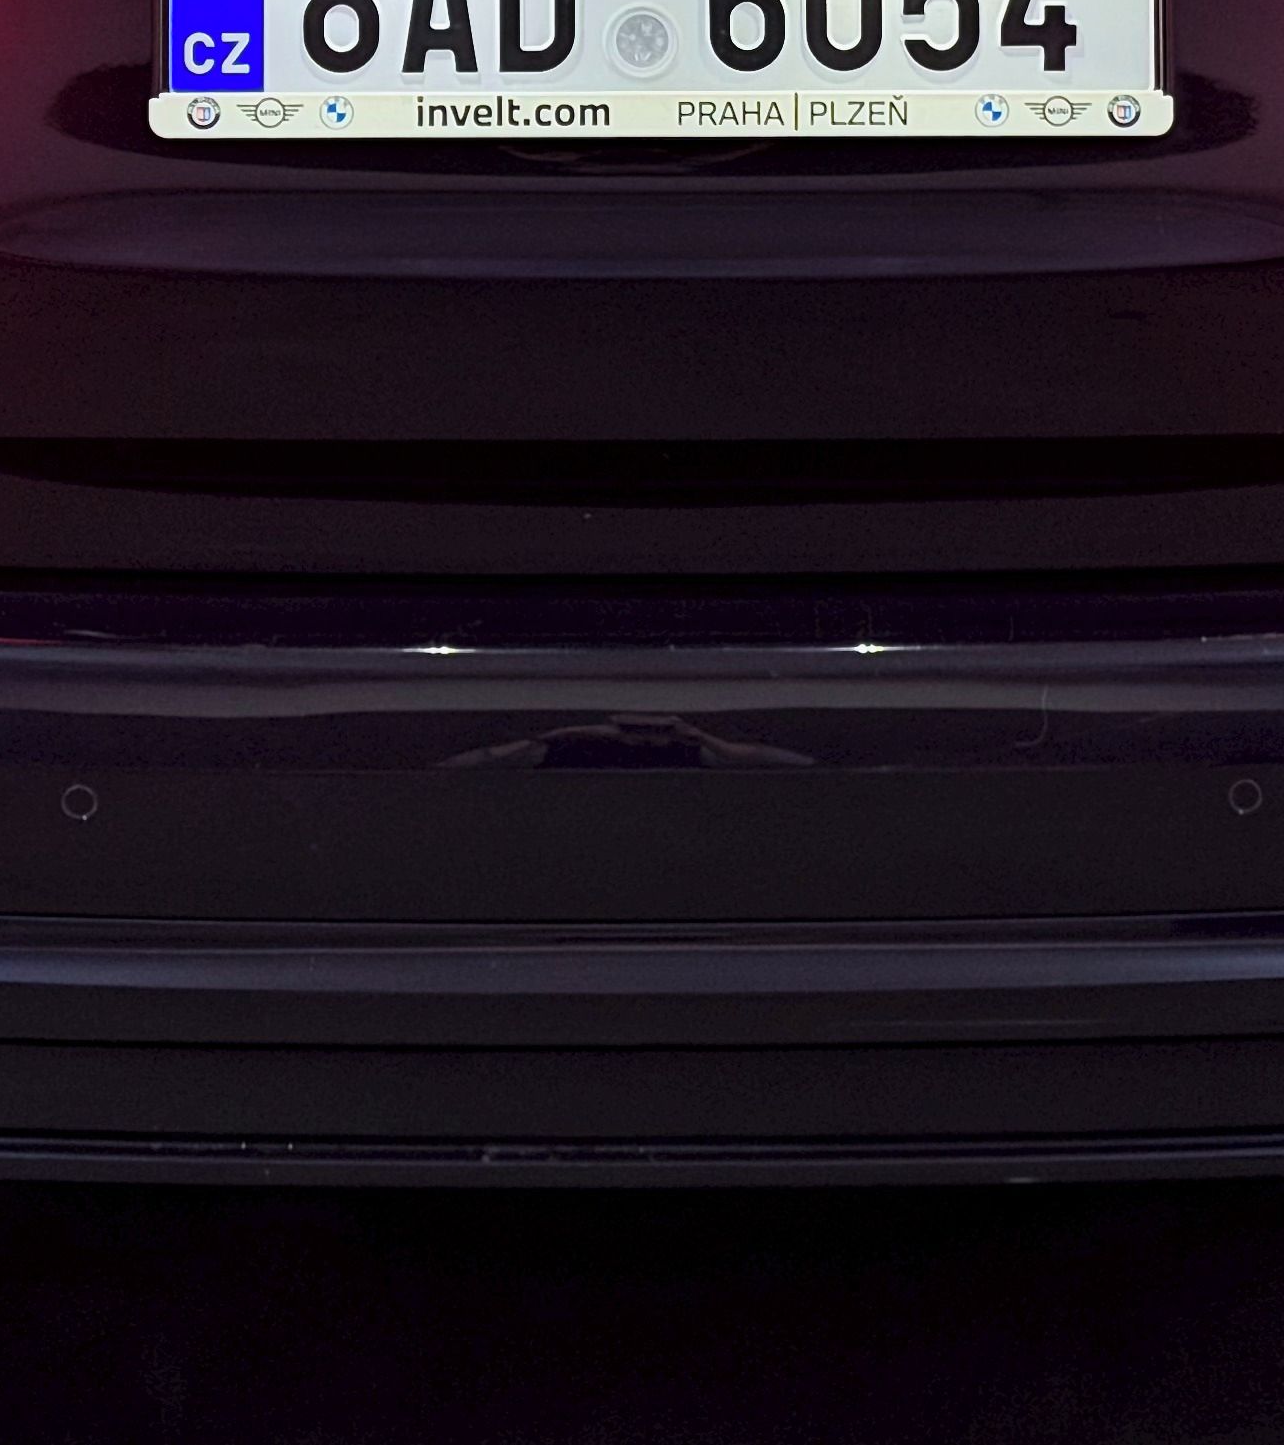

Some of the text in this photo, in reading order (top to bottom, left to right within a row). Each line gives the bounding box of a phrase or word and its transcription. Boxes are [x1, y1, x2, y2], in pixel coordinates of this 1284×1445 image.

[183, 32, 251, 75] CZ
[417, 96, 610, 127] invelt.com
[677, 95, 908, 126] PRAHA PLZEŇ
